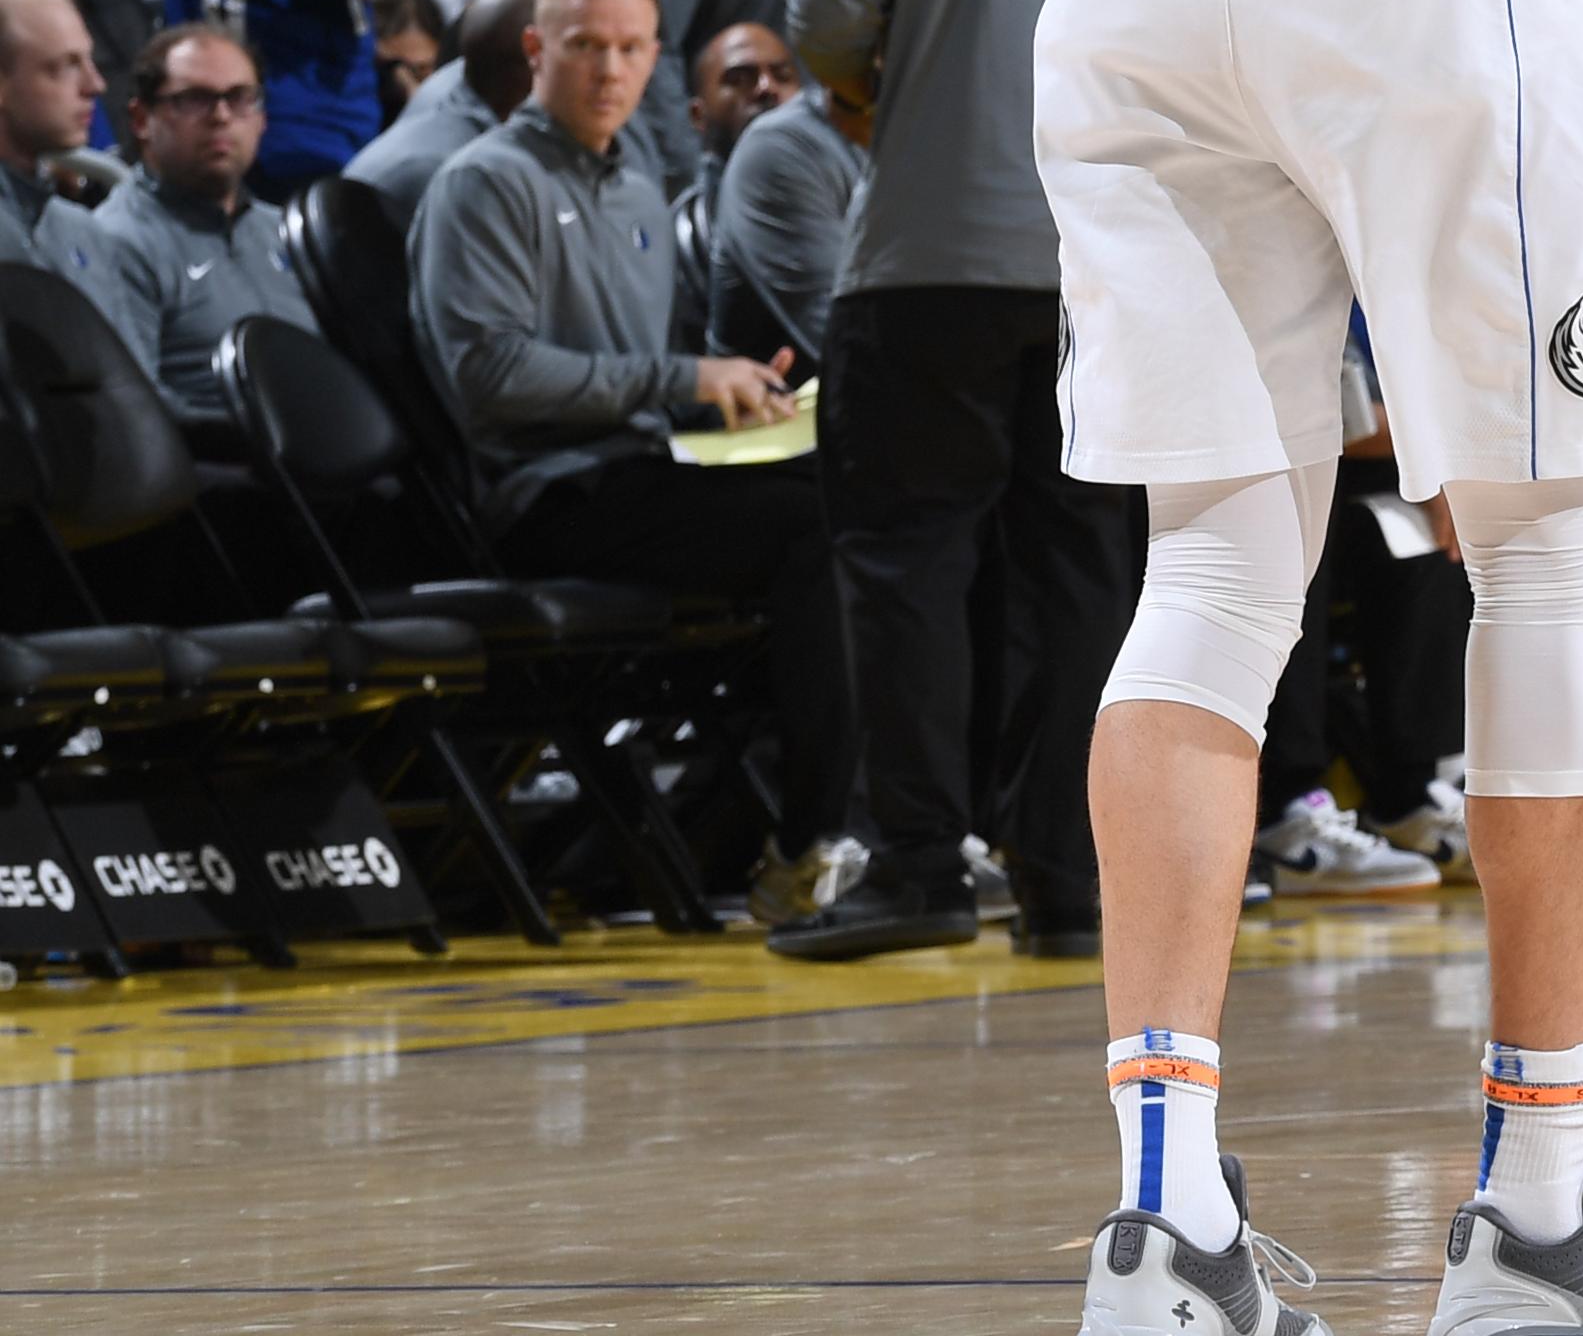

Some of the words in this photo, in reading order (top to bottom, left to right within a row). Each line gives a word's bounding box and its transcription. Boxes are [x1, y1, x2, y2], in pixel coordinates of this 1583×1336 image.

[0, 863, 46, 908] SE
[93, 852, 208, 897] CHASE
[263, 844, 374, 891] CHASE
